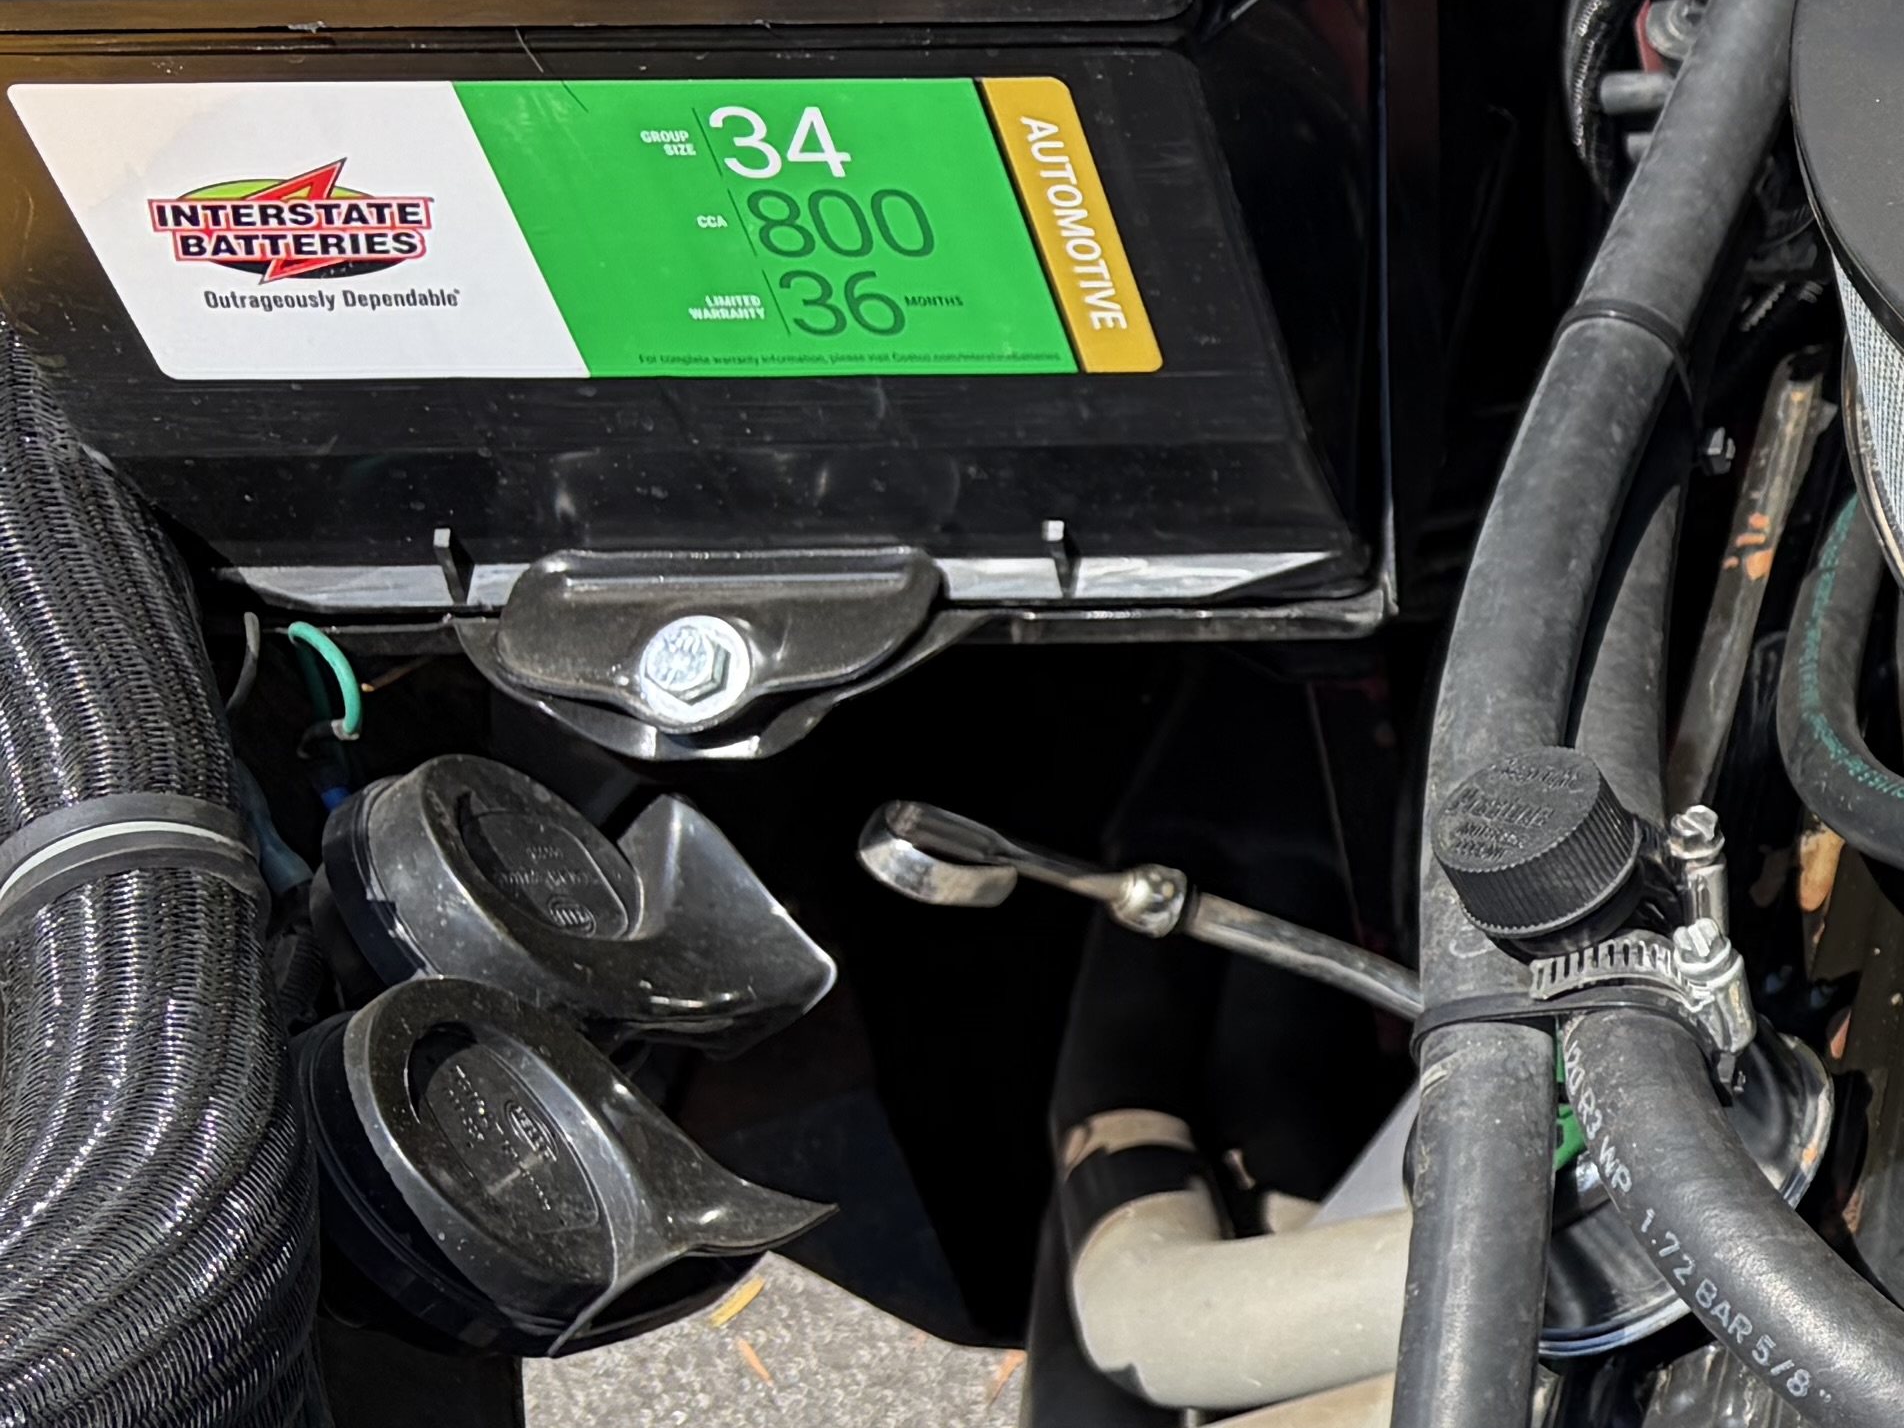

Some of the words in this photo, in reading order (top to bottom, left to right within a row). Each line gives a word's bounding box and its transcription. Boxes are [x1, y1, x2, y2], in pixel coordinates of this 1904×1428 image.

[640, 130, 690, 144] GROUP
[663, 143, 696, 156] SIZE
[708, 106, 851, 179] 34
[155, 202, 423, 228] INTERSTATE
[696, 215, 728, 228] CCA
[746, 188, 935, 259] 800
[1021, 116, 1128, 331] AUTOMOTIVE
[179, 232, 418, 257] BATTERIES
[204, 289, 336, 312] Outrageously
[704, 294, 761, 308] LIMITED
[778, 270, 906, 337] 36
[904, 295, 964, 307] MONTHS
[688, 307, 766, 321] WARRANTY
[1599, 1134, 1633, 1194] WP
[1640, 1207, 1696, 1287] 1.72
[1694, 1277, 1754, 1344] BAR
